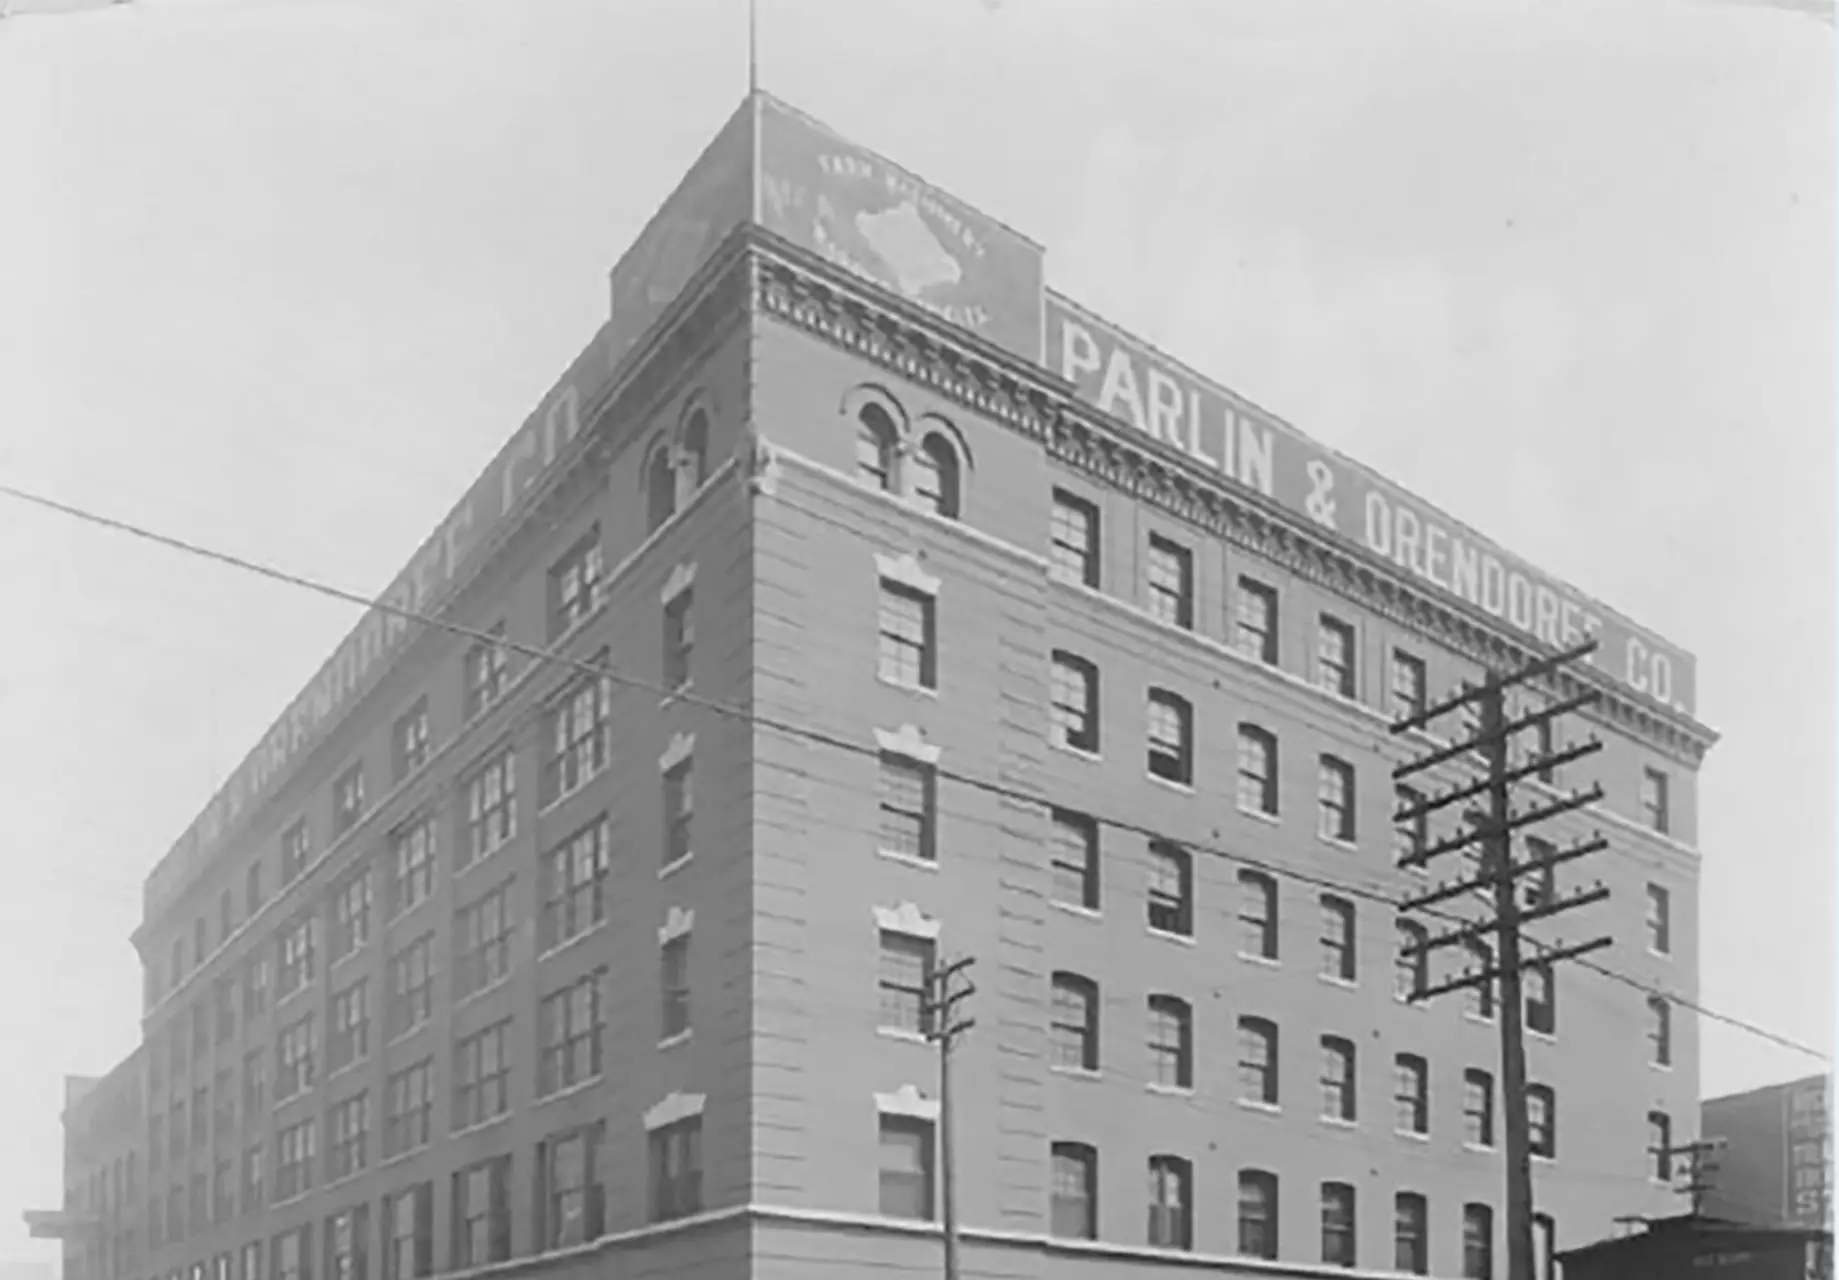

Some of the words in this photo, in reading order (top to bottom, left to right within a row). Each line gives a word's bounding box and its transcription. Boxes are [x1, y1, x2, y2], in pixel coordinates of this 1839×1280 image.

[1062, 319, 1274, 497] PARLIN
[1304, 459, 1336, 530] &
[1627, 635, 1686, 713] CO.
